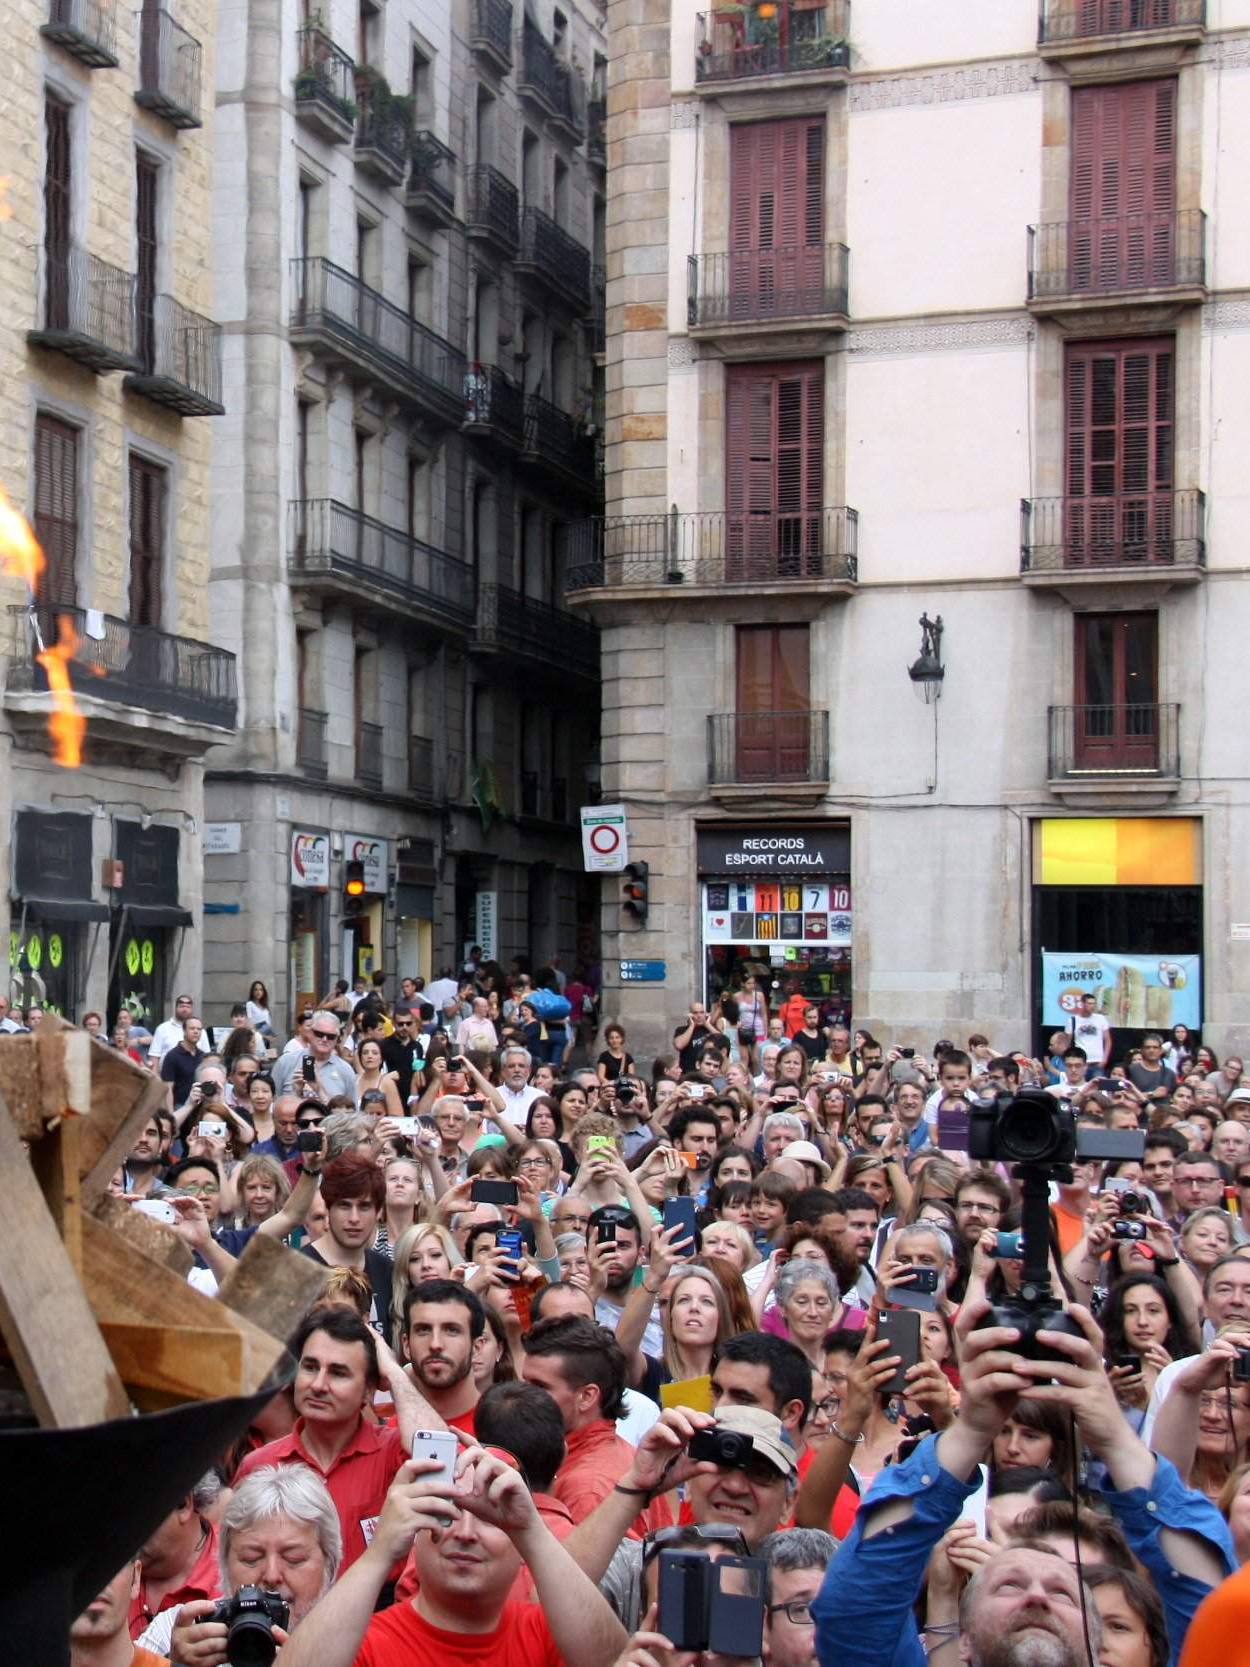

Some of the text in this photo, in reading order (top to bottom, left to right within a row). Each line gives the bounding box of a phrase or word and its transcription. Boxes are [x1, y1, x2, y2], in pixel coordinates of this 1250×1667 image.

[743, 838, 805, 849] RECORDS
[725, 852, 824, 865] ESPORT CATALÀ
[760, 894, 773, 911] 11
[783, 891, 799, 911] 10
[810, 890, 820, 909] 7
[834, 890, 848, 909] 10
[1058, 970, 1103, 982] AHORRO
